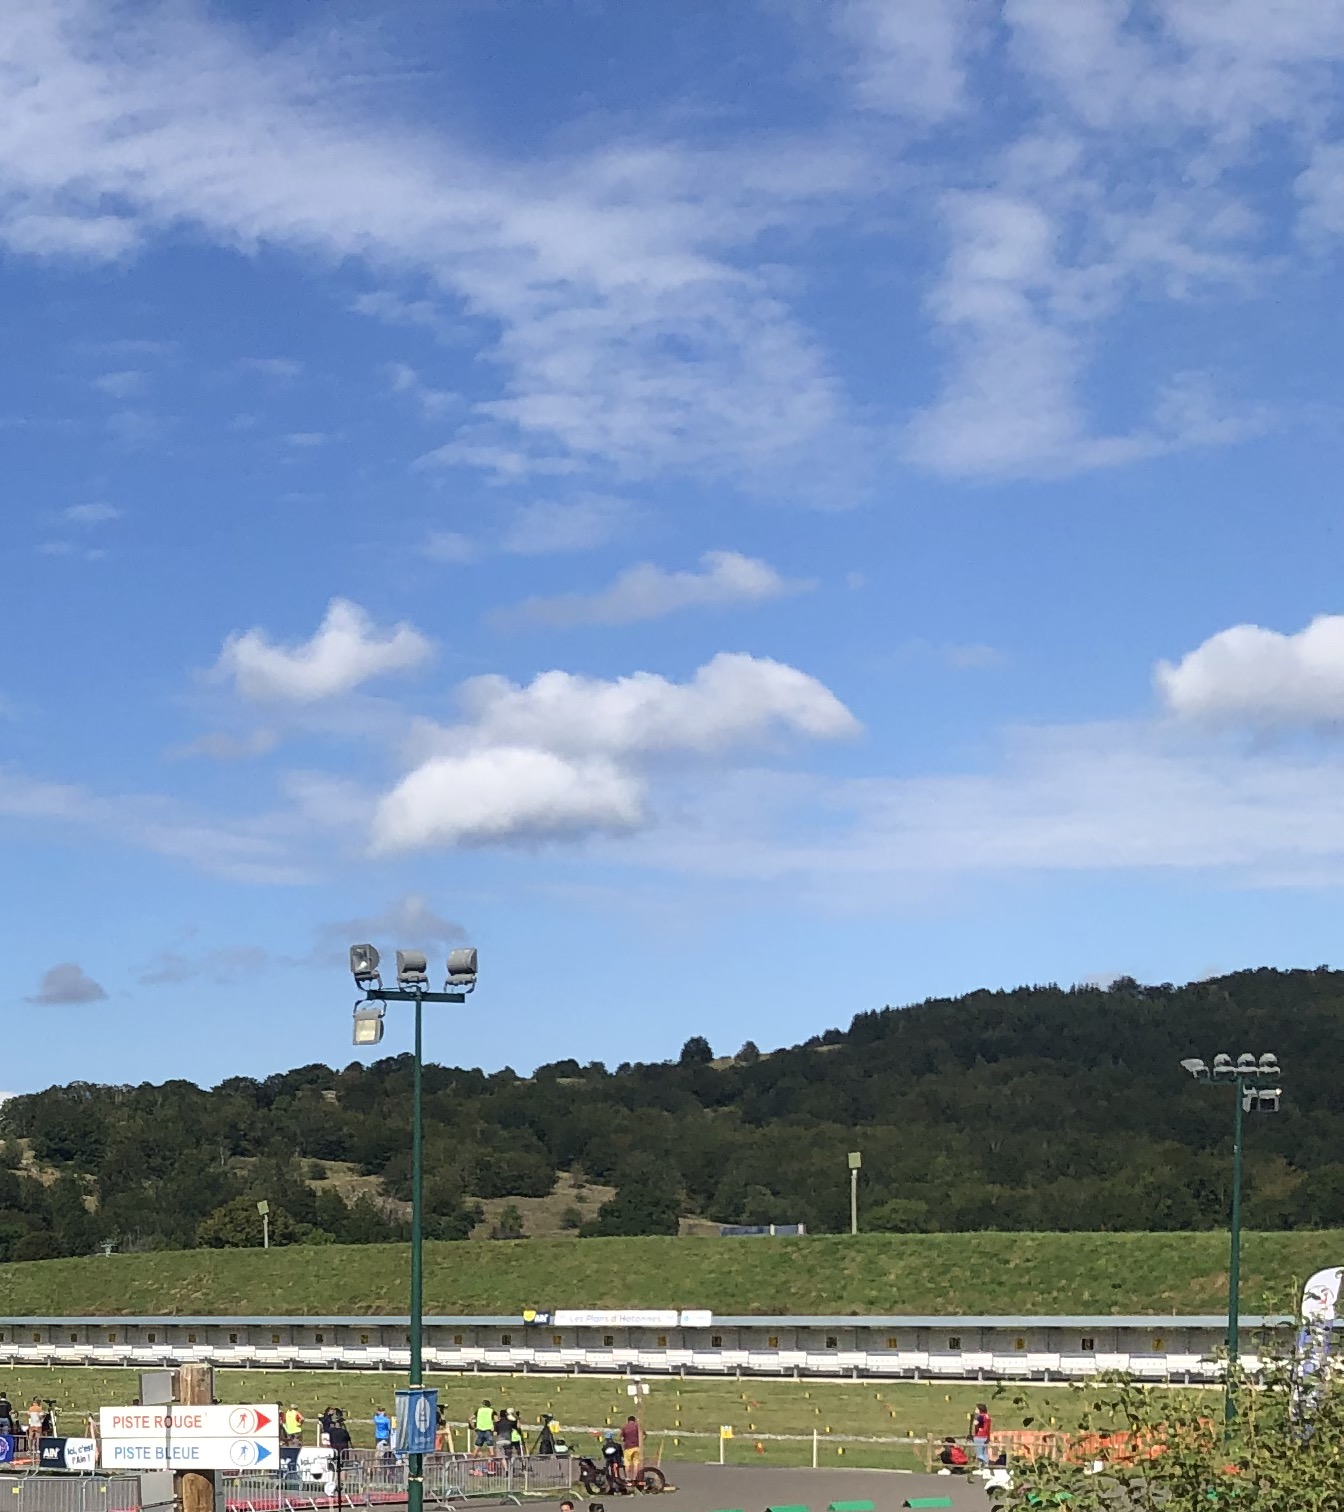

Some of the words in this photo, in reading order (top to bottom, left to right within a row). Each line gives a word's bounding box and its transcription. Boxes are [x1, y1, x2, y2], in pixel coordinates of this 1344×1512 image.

[113, 1415, 150, 1429] PISTE
[155, 1414, 202, 1428] ROUGE
[114, 1446, 151, 1460] PISTE
[155, 1446, 200, 1460] BLEUE
